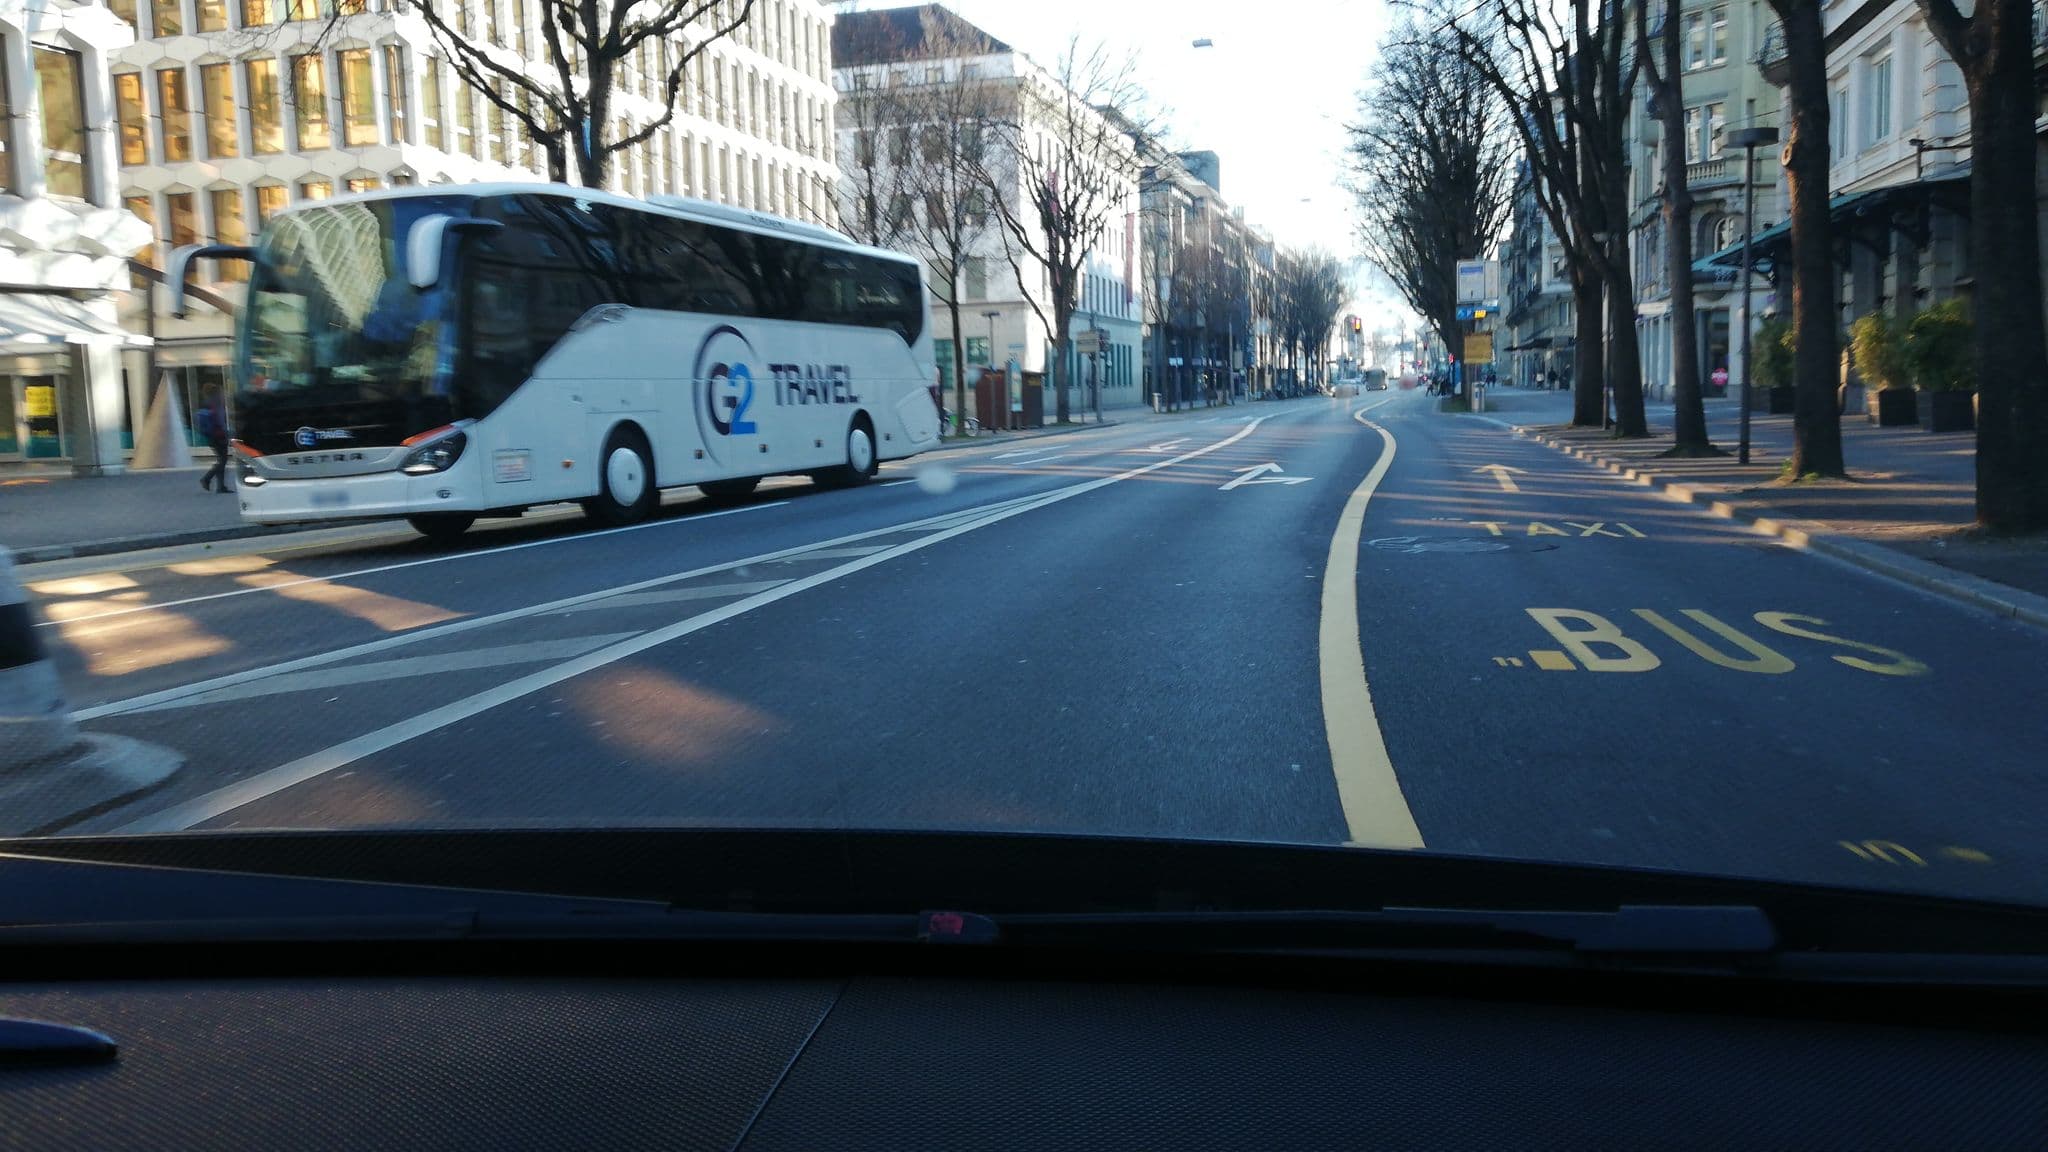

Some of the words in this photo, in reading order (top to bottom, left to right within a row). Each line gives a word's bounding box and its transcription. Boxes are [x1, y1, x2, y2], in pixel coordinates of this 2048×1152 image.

[707, 362, 757, 435] G2
[768, 363, 859, 405] TRAVEL
[288, 453, 364, 465] SETRA
[1468, 520, 1647, 537] TAXI
[1525, 607, 1931, 676] BUS
